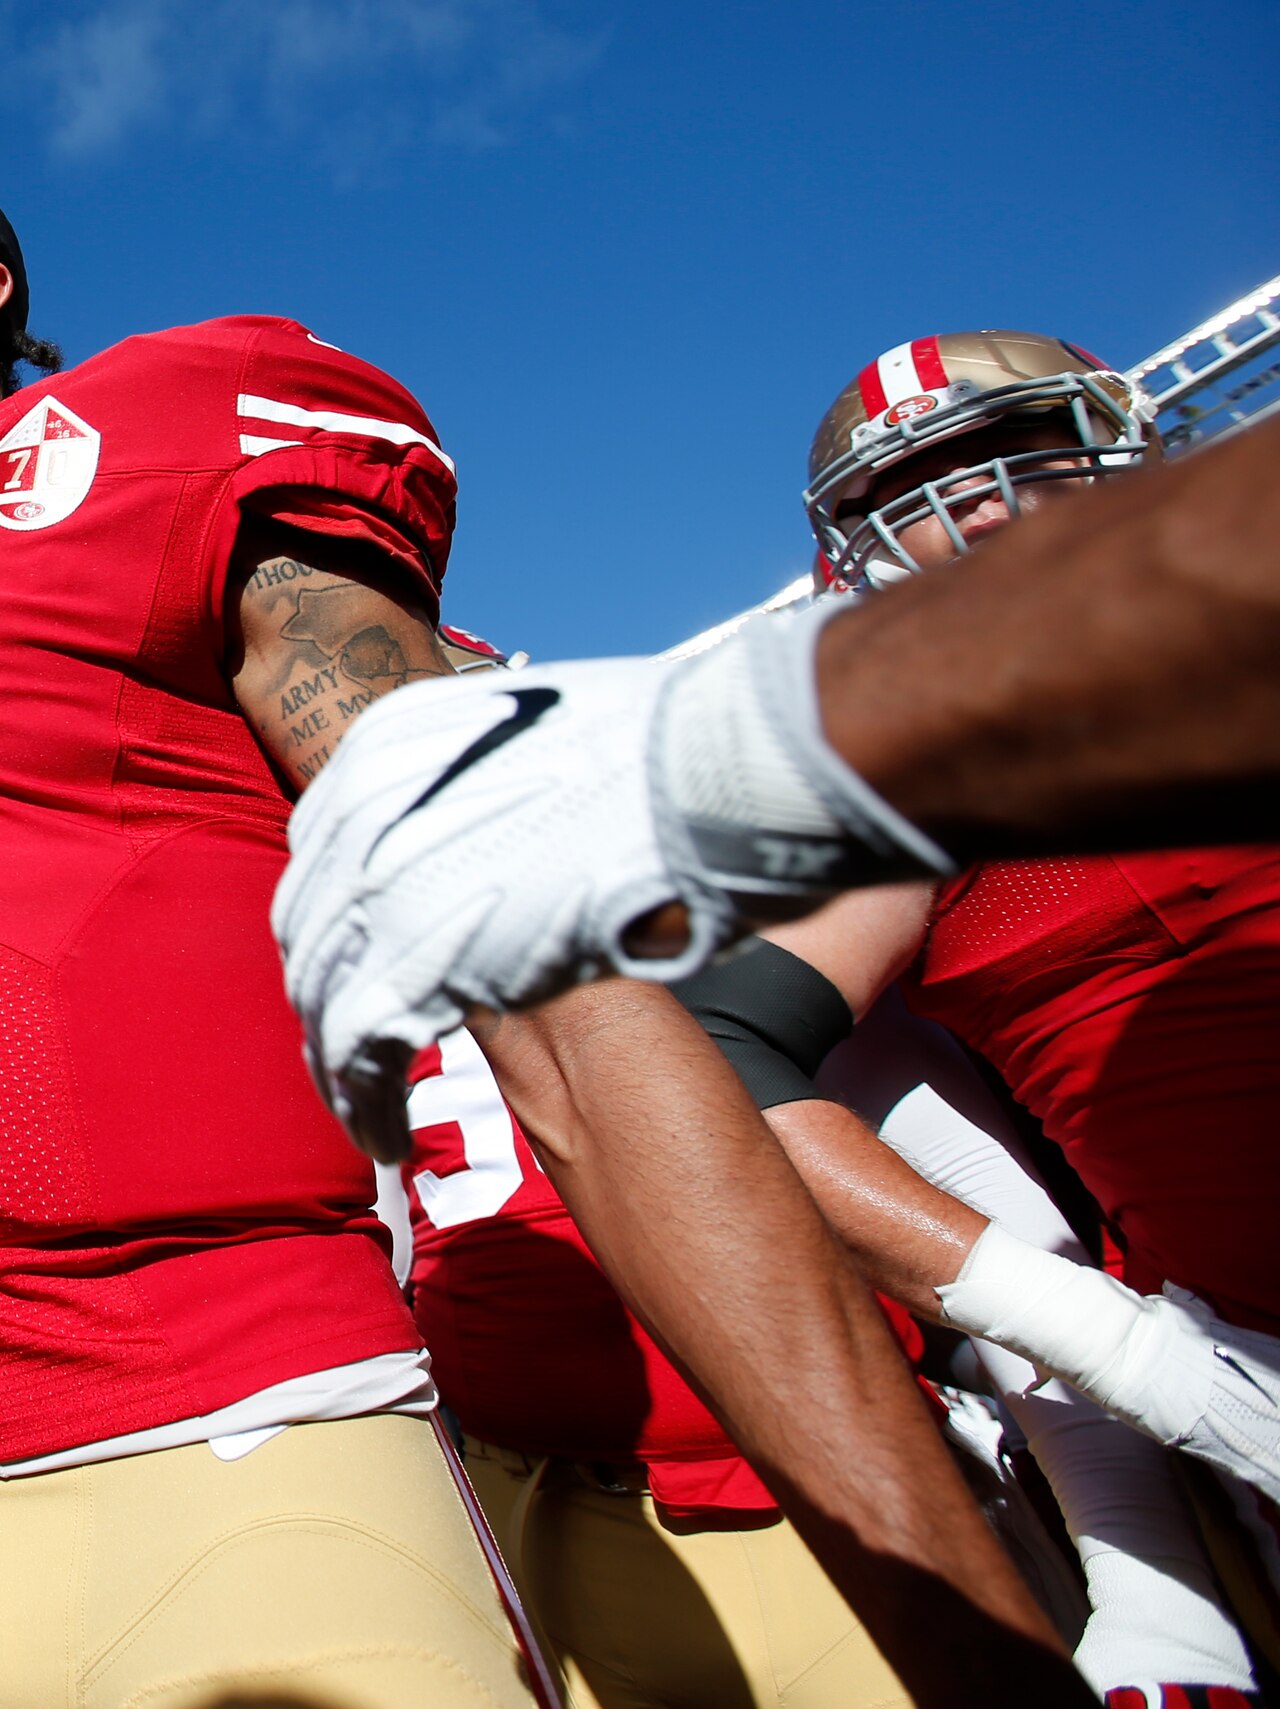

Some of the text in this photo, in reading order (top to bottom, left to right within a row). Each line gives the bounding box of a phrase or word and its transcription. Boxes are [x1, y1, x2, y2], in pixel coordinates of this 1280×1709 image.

[4, 449, 68, 490] 70
[280, 665, 339, 720] ARMY
[289, 708, 331, 747] ME
